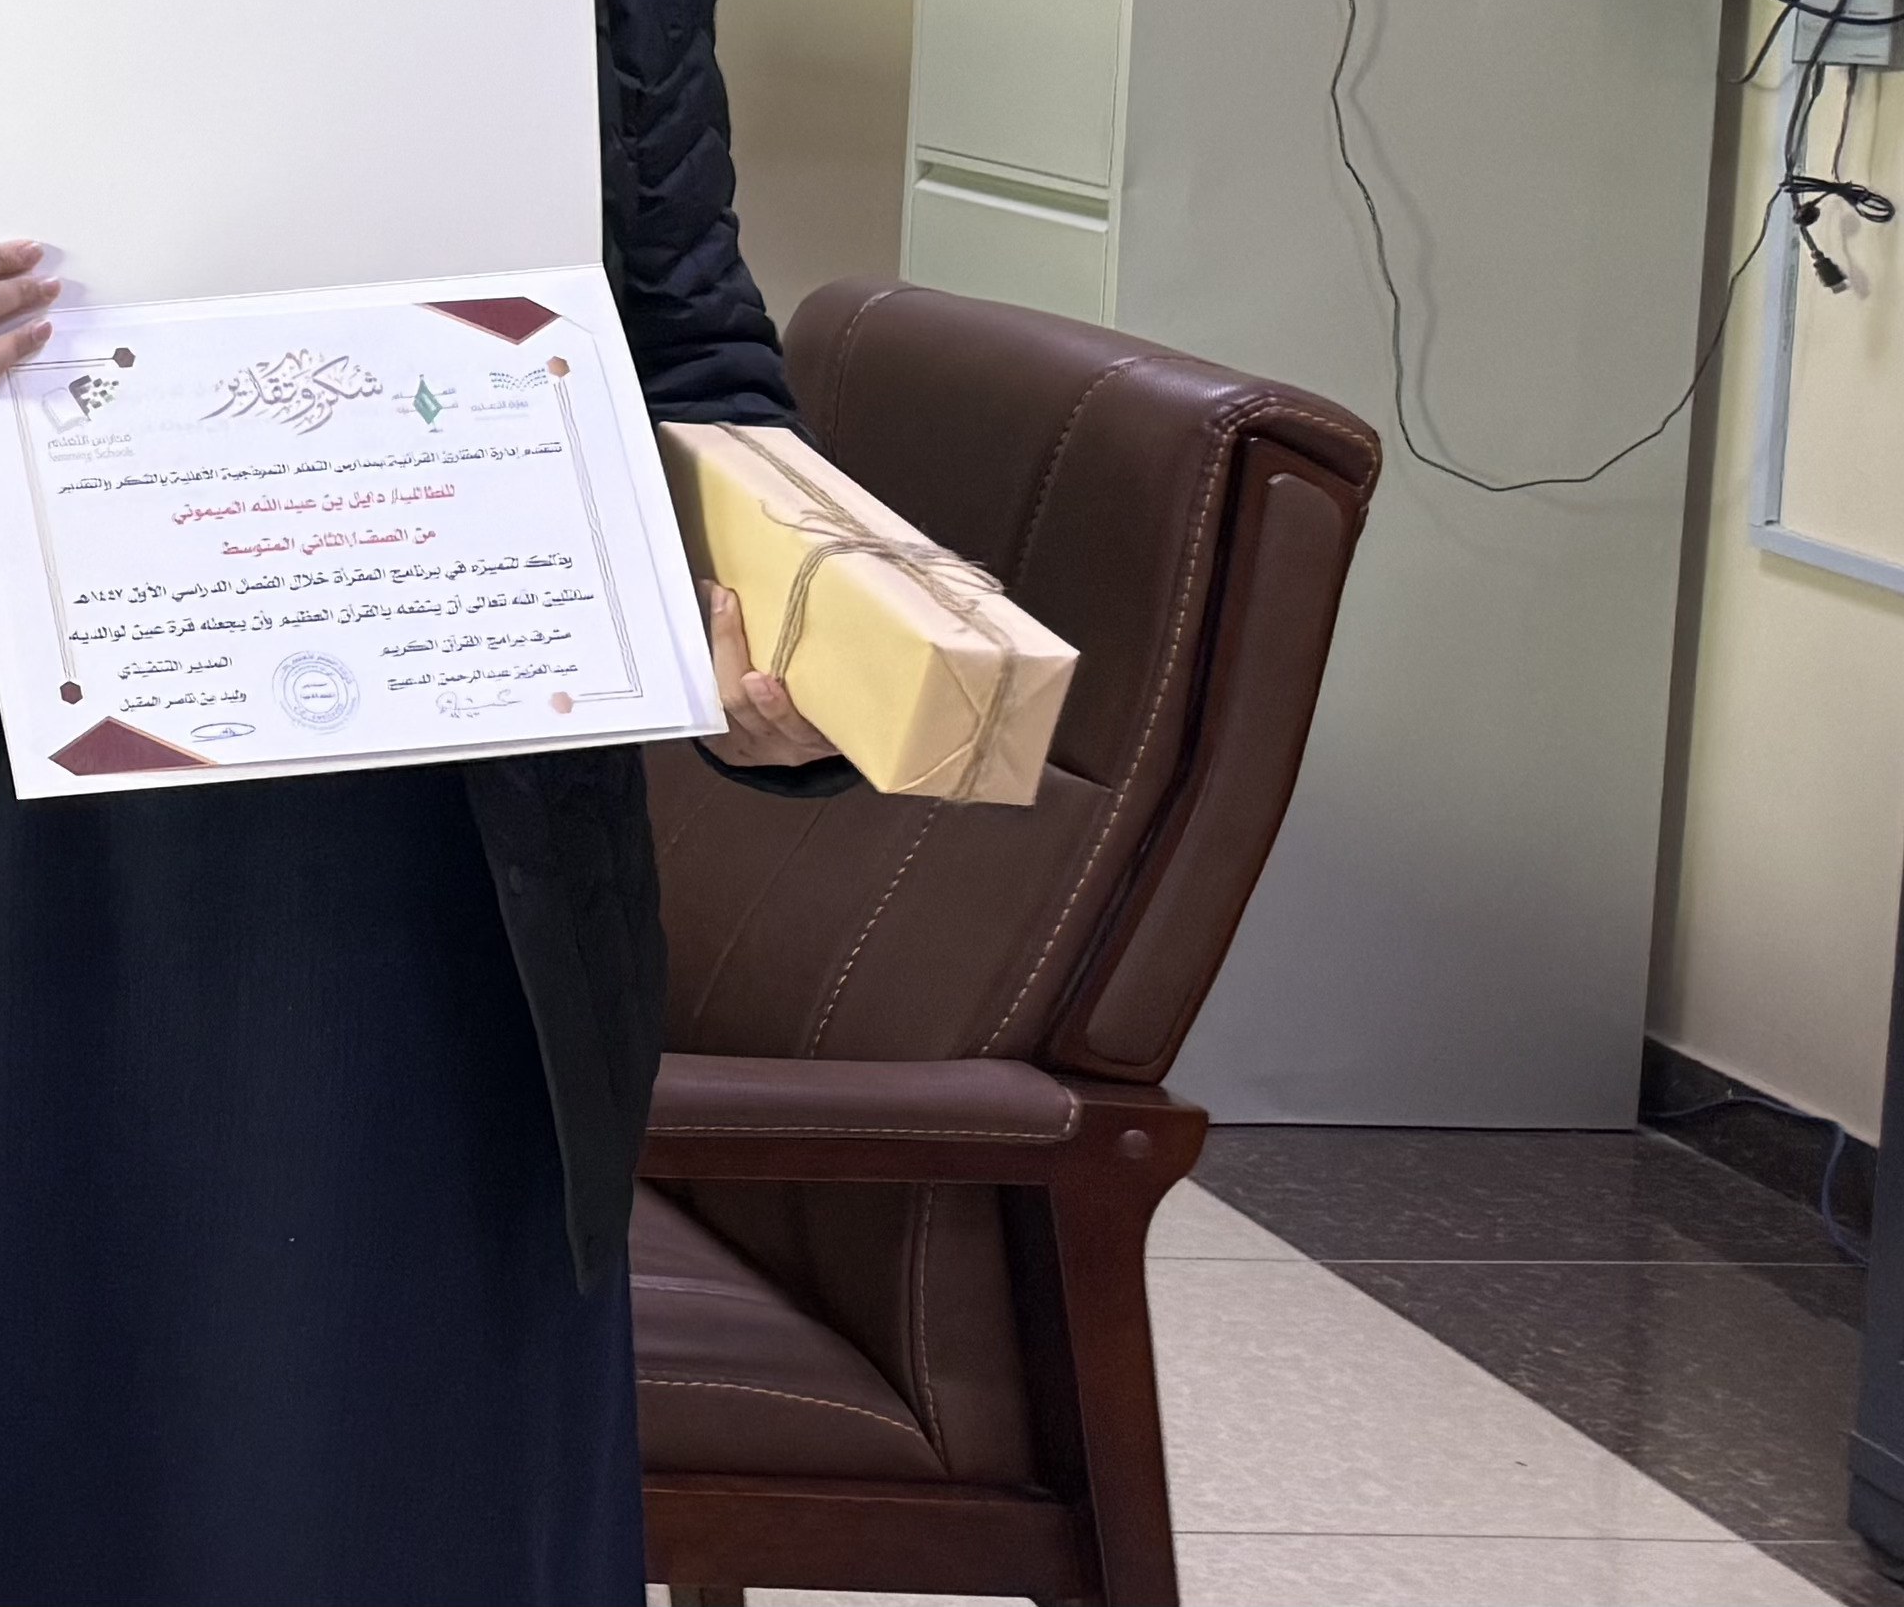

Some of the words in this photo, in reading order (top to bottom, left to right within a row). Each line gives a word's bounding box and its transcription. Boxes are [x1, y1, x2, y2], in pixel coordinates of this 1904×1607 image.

[171, 499, 246, 525] الميموني
[321, 494, 343, 512] بن
[412, 527, 437, 545] من
[220, 536, 296, 558] المتوسط
[390, 565, 442, 584] برنامج
[444, 561, 467, 581] في
[171, 579, 233, 603] الدراسي
[235, 575, 286, 595] الفصل
[289, 572, 330, 591] خلال
[127, 581, 167, 604] الأول
[445, 594, 462, 615] أن
[465, 593, 508, 613] تعالى
[168, 617, 196, 637] قرة
[200, 617, 247, 632] يجعله
[250, 610, 273, 631] وأن
[278, 608, 334, 627] العظيم
[131, 623, 166, 641] عين
[379, 640, 440, 657] الكريم
